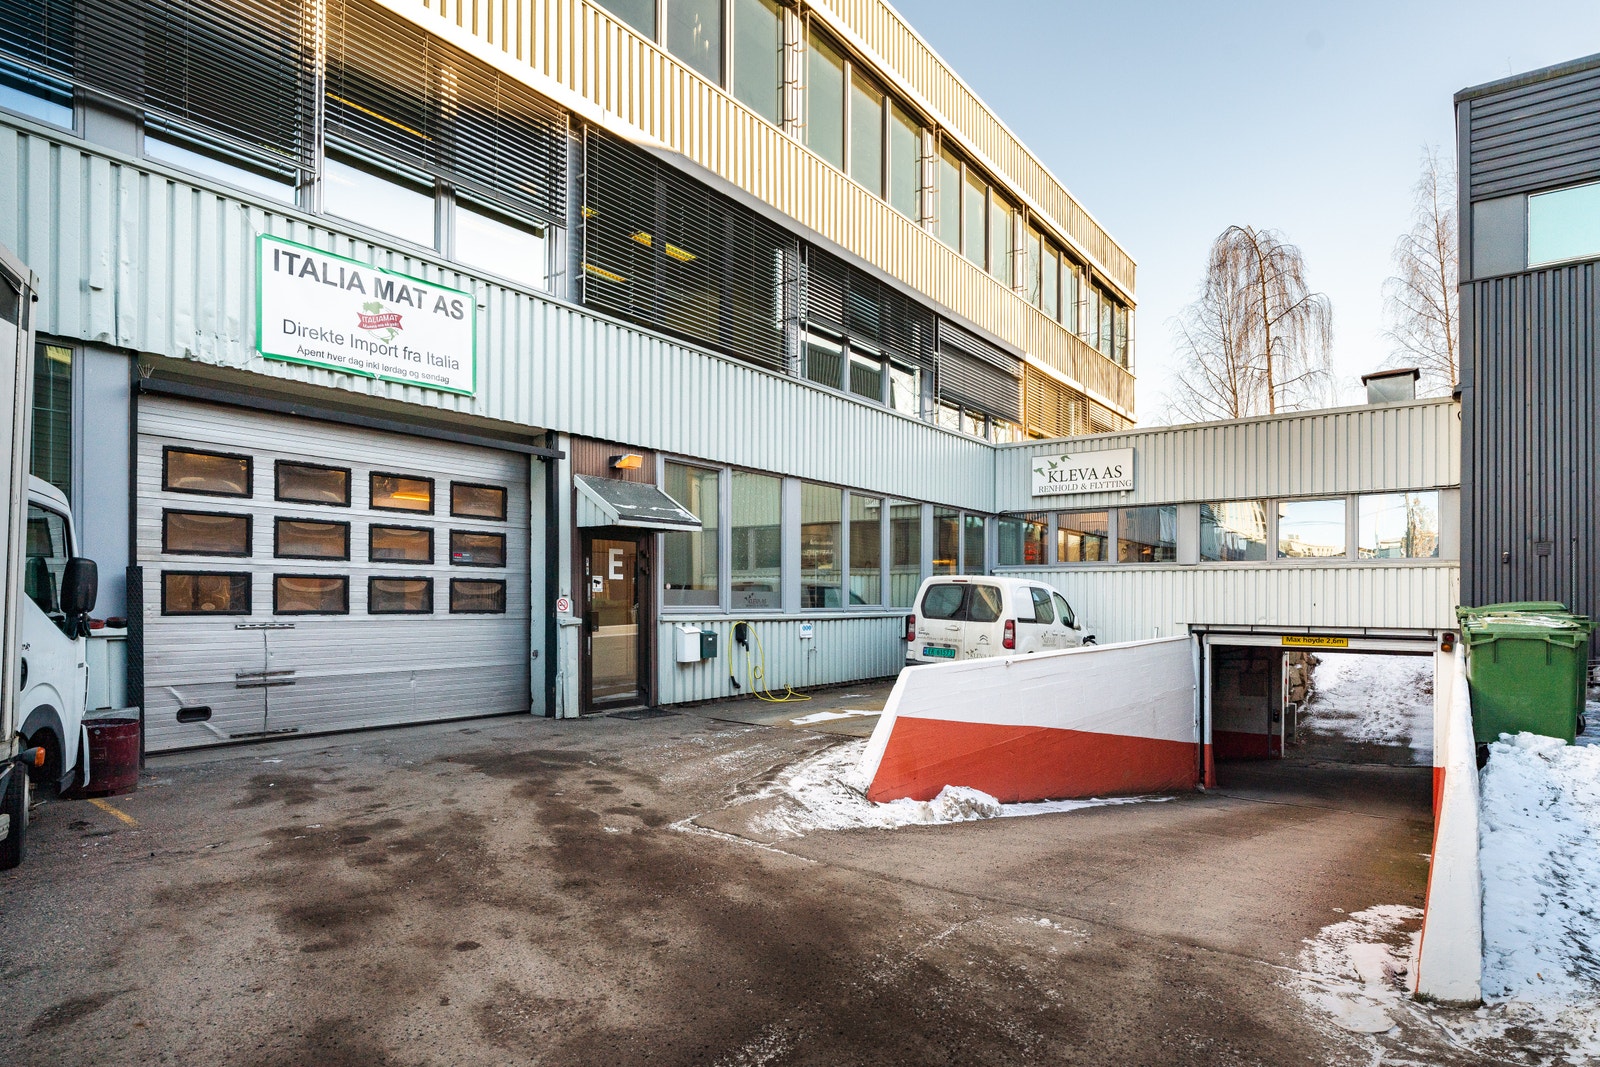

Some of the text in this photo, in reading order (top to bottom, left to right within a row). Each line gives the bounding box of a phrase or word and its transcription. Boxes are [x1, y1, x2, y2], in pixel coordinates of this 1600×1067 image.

[274, 248, 464, 320] ITALIA MAT AS
[362, 314, 399, 323] ITALIAMAT
[283, 319, 459, 370] Direkte Import fra Italia
[327, 352, 346, 362] hver
[348, 356, 364, 368] dag
[366, 359, 380, 370] inkl
[382, 363, 407, 377] lørdag
[409, 370, 419, 379] og
[421, 372, 450, 384] søndag
[1038, 480, 1132, 493] RENHOLD & FLYTTING
[1048, 465, 1122, 483] KLEVA AS
[608, 548, 624, 580] E
